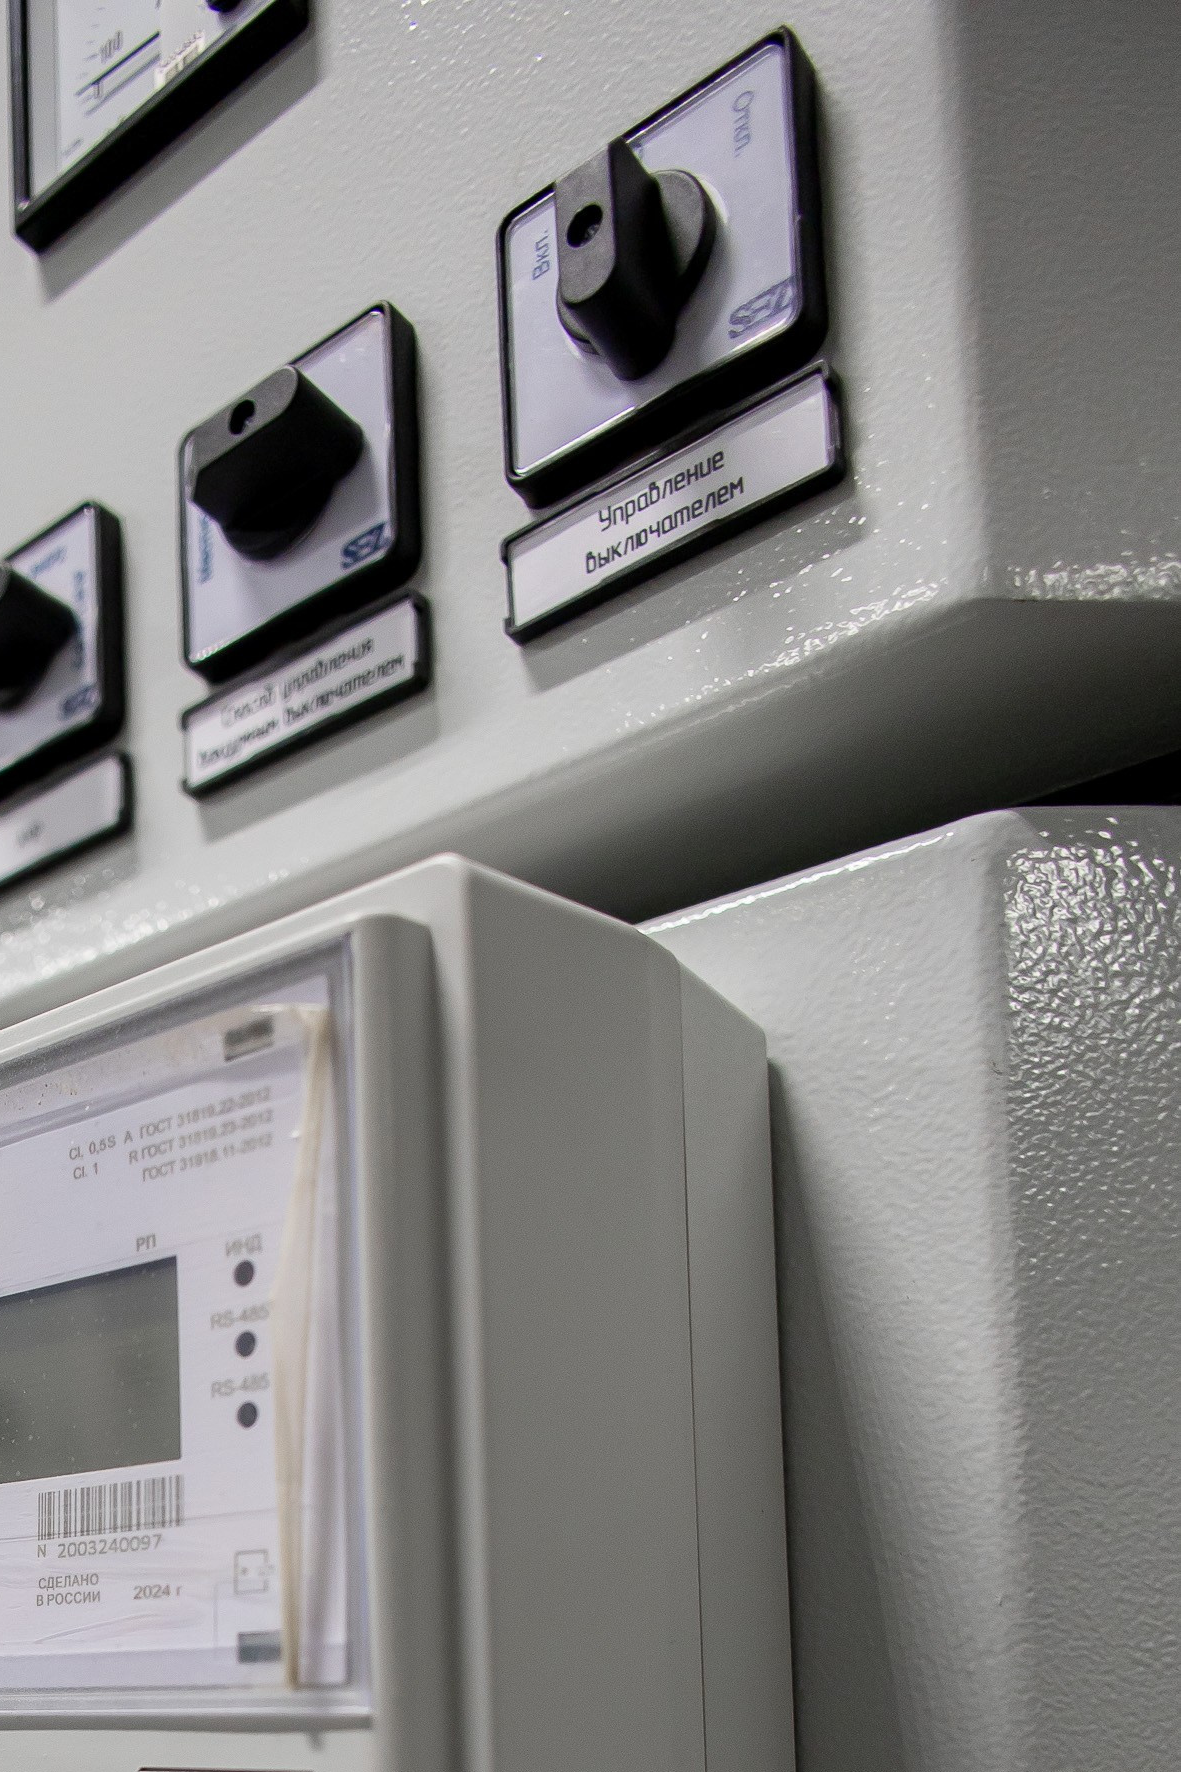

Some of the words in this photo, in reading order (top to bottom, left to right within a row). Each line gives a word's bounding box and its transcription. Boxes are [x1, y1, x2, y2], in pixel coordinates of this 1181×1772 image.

[732, 90, 754, 158] Откл.
[532, 229, 550, 281] Вкл.
[598, 450, 725, 532] Управление
[585, 476, 744, 574] выключателем
[89, 1135, 116, 1155] 0,5S
[139, 1117, 173, 1139] ГОСТ
[93, 1162, 99, 1175] 1
[141, 1139, 174, 1160] ГОСТ
[143, 1160, 176, 1181] ГОСТ
[210, 1303, 269, 1331] RS-485
[211, 1372, 269, 1399] RS-485
[37, 1544, 47, 1558] N
[57, 1533, 163, 1559] 2003240097
[38, 1573, 99, 1592] СДЕЛАНО
[133, 1583, 172, 1600] 2024
[36, 1595, 44, 1606] В
[47, 1590, 101, 1606] РОССИИ
